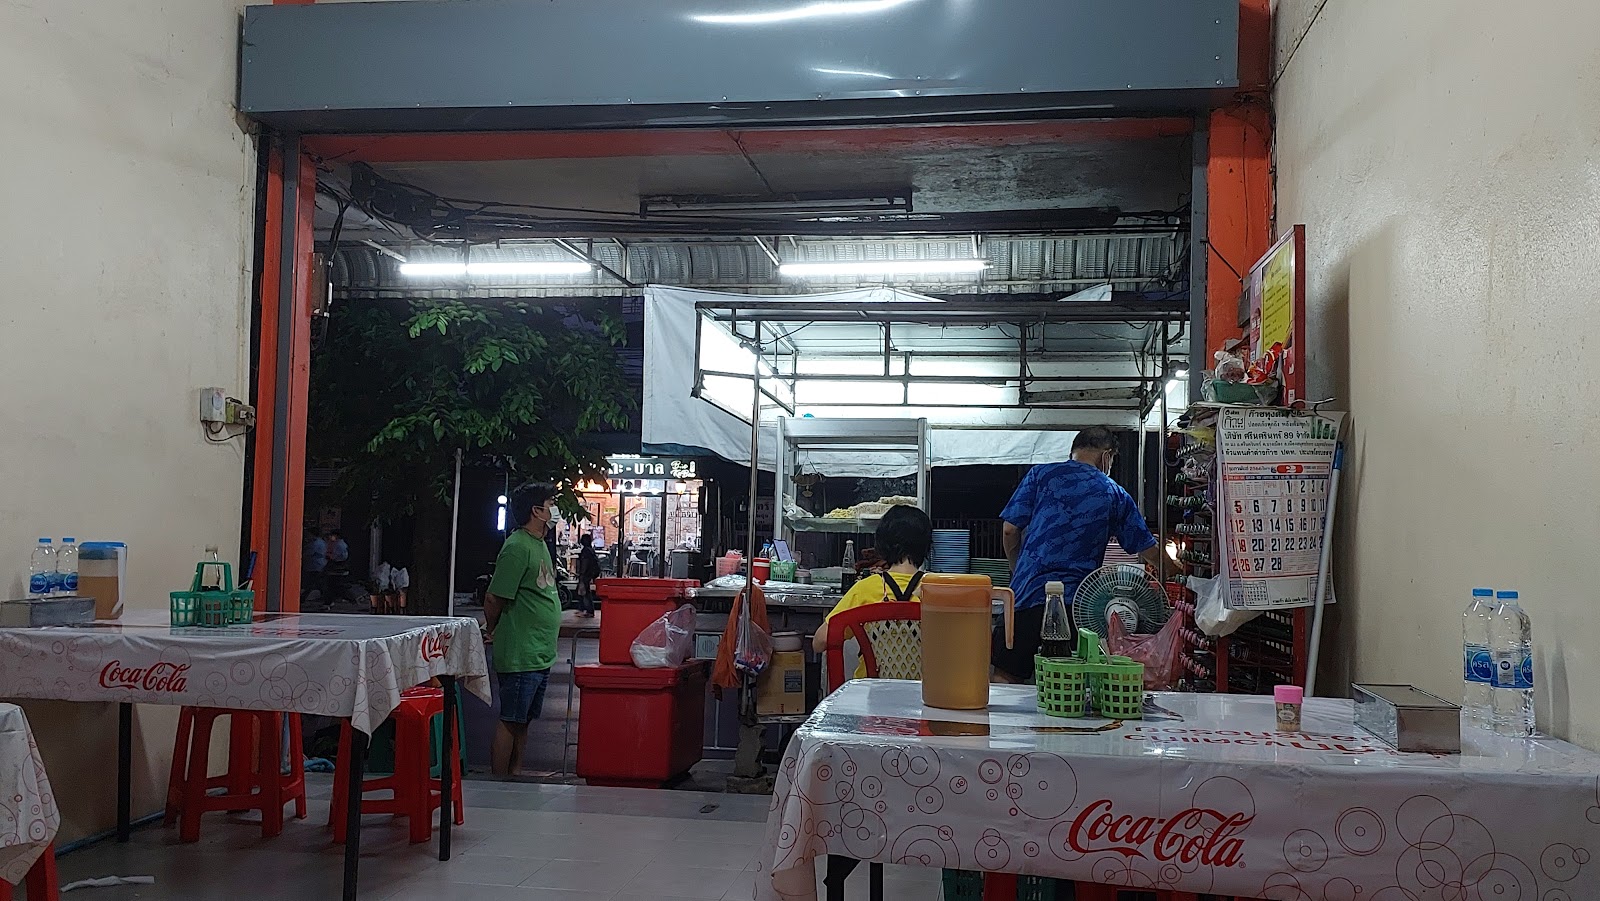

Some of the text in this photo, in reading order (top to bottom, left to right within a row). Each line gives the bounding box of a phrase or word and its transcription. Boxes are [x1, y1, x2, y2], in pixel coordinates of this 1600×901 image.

[1224, 431, 1242, 440] บริษัท
[1283, 431, 1294, 440] 89
[1286, 480, 1291, 493] 1
[1300, 480, 1306, 493] 2
[1234, 500, 1243, 513] 5
[1253, 500, 1260, 513] 6
[1271, 499, 1277, 512] 7
[1287, 499, 1293, 512] 8
[1301, 499, 1306, 512] 9
[1251, 518, 1263, 533] 13
[1269, 517, 1280, 532] 14
[1284, 517, 1294, 532] 15
[1300, 517, 1307, 531] 16
[1310, 517, 1316, 530] 17
[1251, 538, 1265, 552] 20
[1270, 538, 1280, 552] 21
[1285, 537, 1295, 551] 22
[1298, 536, 1308, 550] 23
[1309, 536, 1316, 550] 24
[1253, 557, 1265, 571] 27
[1270, 557, 1282, 571] 28
[99, 659, 193, 693] Coca-Cola
[1069, 799, 1257, 868] Coca-Cola
